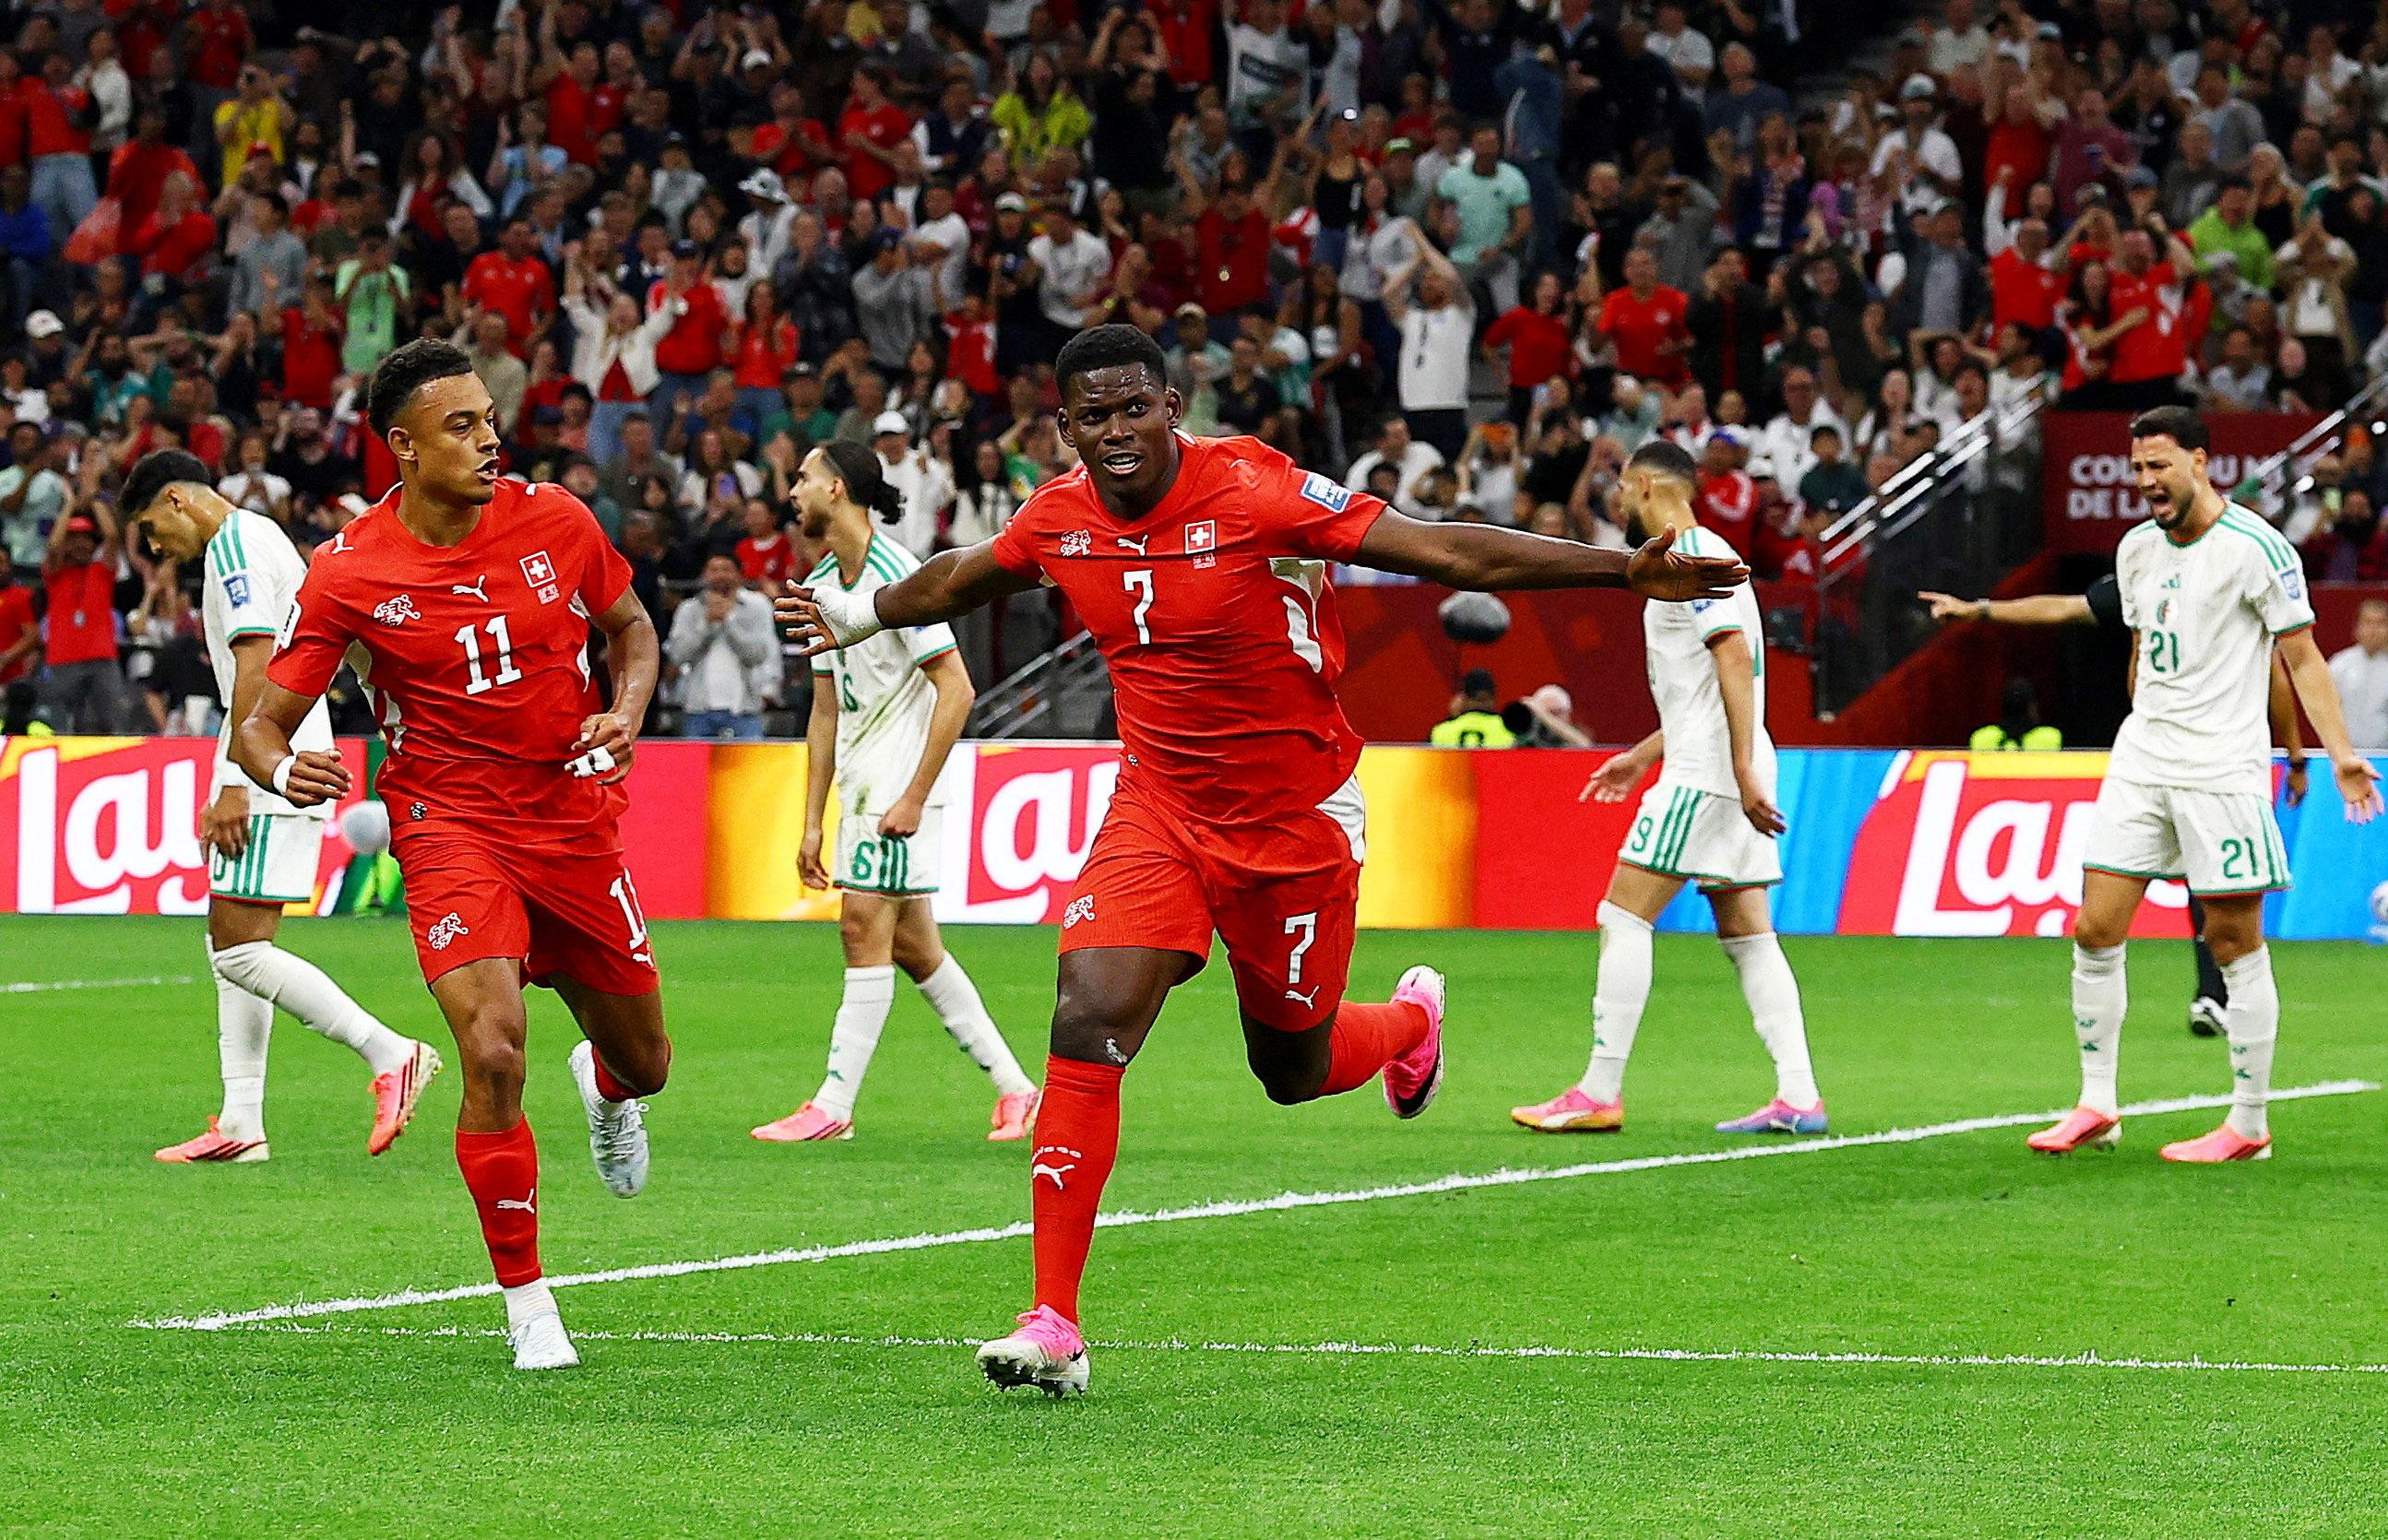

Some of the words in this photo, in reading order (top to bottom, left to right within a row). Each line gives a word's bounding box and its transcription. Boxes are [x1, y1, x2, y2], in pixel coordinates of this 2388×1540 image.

[2070, 455, 2136, 486] COU
[2068, 489, 2113, 519] DE
[1123, 570, 1154, 645] 7
[454, 615, 522, 694] 11
[2150, 630, 2179, 673] 21
[842, 673, 859, 713] 6
[1631, 816, 1654, 853] 9
[852, 840, 876, 881] 6
[2221, 835, 2258, 879] 21
[1284, 912, 1317, 984] 7
